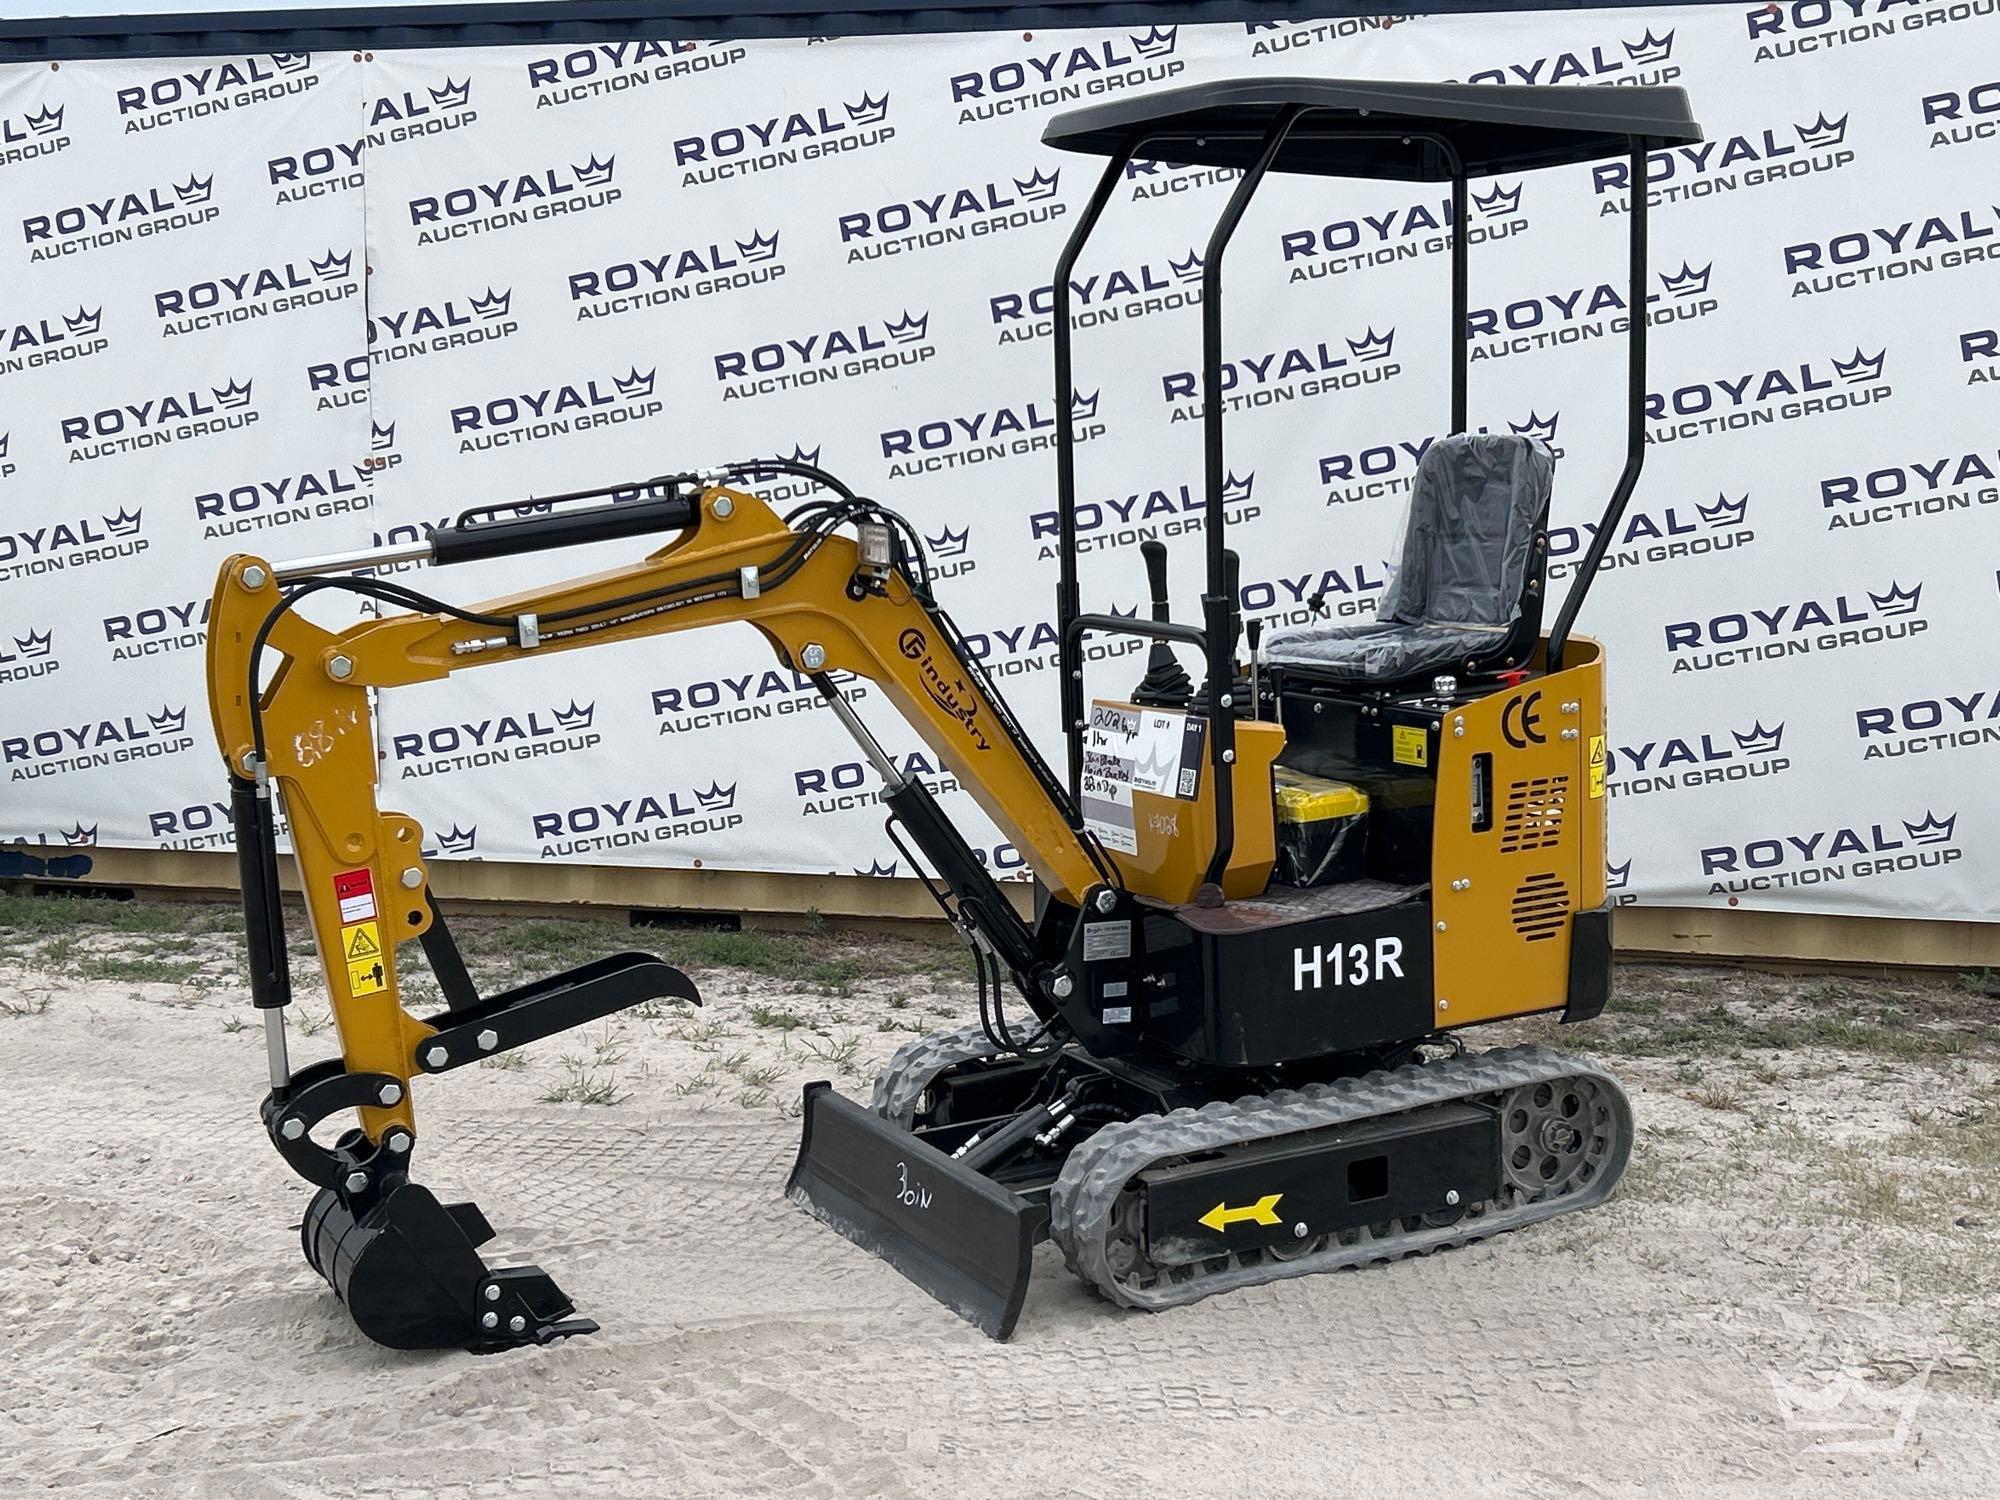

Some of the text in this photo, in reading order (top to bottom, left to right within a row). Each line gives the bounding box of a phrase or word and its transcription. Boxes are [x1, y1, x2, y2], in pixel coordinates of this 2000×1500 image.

[1252, 16, 1382, 57] AUCTION
[1754, 20, 1895, 63] AUCTION
[117, 57, 274, 115] ROYAL
[536, 48, 745, 109] AUCTION GROUP
[951, 41, 1132, 103] ROYAL
[959, 61, 1184, 125] AUCTION GROUP
[125, 75, 319, 134] AUCTION GROUP
[391, 111, 477, 142] GROUP
[673, 108, 846, 165] ROYAL
[682, 127, 895, 187] AUCTION GROUP
[268, 138, 365, 185] ROY
[1131, 167, 1244, 202] AUCTIO
[1592, 130, 1796, 194] ROYAL
[1744, 151, 1854, 186] GROUP
[276, 173, 364, 205] AUCTIO
[409, 169, 574, 226] ROYAL
[838, 183, 1015, 242] ROYAL
[22, 188, 176, 244] ROYAL
[31, 207, 219, 263] AUCTION GROUP
[418, 189, 621, 246] AUCTION GROUP
[848, 204, 1066, 264] AUCTION GROUP
[1281, 199, 1473, 261] ROYAL
[1290, 243, 1417, 283] AUCTION
[1784, 211, 1994, 274] ROYAL
[155, 264, 312, 317] ROYAL
[567, 245, 738, 301] ROYAL
[577, 265, 785, 321] AUCTION GROUP
[990, 265, 1169, 324] ROYAL
[1792, 243, 2000, 297] AUCTION GRO
[163, 283, 358, 337] AUCTION GROUP
[367, 302, 472, 346] YAL
[999, 289, 1203, 345] AUCION GROU
[1466, 280, 1661, 340] ROYA
[28, 339, 108, 367] GROUP
[369, 322, 518, 364] TION GROUP
[714, 326, 885, 380] ROYAL
[1470, 322, 1603, 362] AUCTION
[723, 346, 935, 401] AUCTION GROUP
[1170, 364, 1400, 424] AUTION GROUP
[1645, 363, 1833, 421] ROYAL
[61, 392, 214, 443] ROYAL
[450, 381, 614, 433] ROYAL
[460, 402, 662, 454] AUCTION GROUP
[880, 403, 1054, 458] ROYAL
[1645, 386, 1891, 445] AUCTION GROUP
[69, 412, 259, 463] AUCTION GROUP
[889, 444, 1005, 479] AUCTION
[1319, 437, 1436, 485] ROY
[195, 469, 356, 520] ROYAL
[748, 481, 828, 504] ROUP
[1326, 476, 1417, 507] AUCTI
[1820, 450, 2000, 508] ROYA
[204, 493, 373, 539] AUCTION GRO
[1030, 485, 1206, 540] ROYAL
[1037, 506, 1261, 561] ACTION GRUP
[1547, 508, 1697, 557] OAL
[1828, 493, 1970, 531] AUCTION
[0, 520, 105, 561] OYAL
[0, 540, 149, 582] CTION GROUP
[1548, 531, 1754, 580] CTON GROUP
[1240, 565, 1383, 611] OYAL
[103, 599, 212, 642] ROY
[957, 622, 1093, 661] OYA
[1665, 596, 1868, 652] ROYAL
[971, 656, 1044, 682] TION
[1050, 639, 1144, 667] GOUP
[1672, 620, 1928, 674] AUCTION GROUP
[0, 660, 60, 684] ROUP
[651, 670, 817, 715] ROYAL
[393, 713, 554, 760] ROYAL
[660, 704, 771, 735] AUCTION
[1186, 722, 1198, 732] DAY
[1502, 691, 1546, 749] CE
[1856, 691, 2000, 738] ROY
[2, 717, 150, 763] ROYAL
[12, 738, 193, 781] AUCTION GROUP
[402, 734, 600, 779] AUCTION GROUP
[1606, 735, 1733, 776] YAL
[1864, 728, 2000, 760] AUCTION
[1606, 758, 1790, 798] TION GROUP
[149, 801, 234, 837] ROY
[533, 793, 695, 839] ROYAL
[803, 791, 879, 816] AUCTI
[160, 829, 236, 850] AUCTIO
[541, 815, 742, 858] AUCTION GROUP
[1700, 824, 1903, 876] ROYAL
[1708, 849, 1961, 895] AUCTION GROUP
[1293, 936, 1404, 991] H13R
